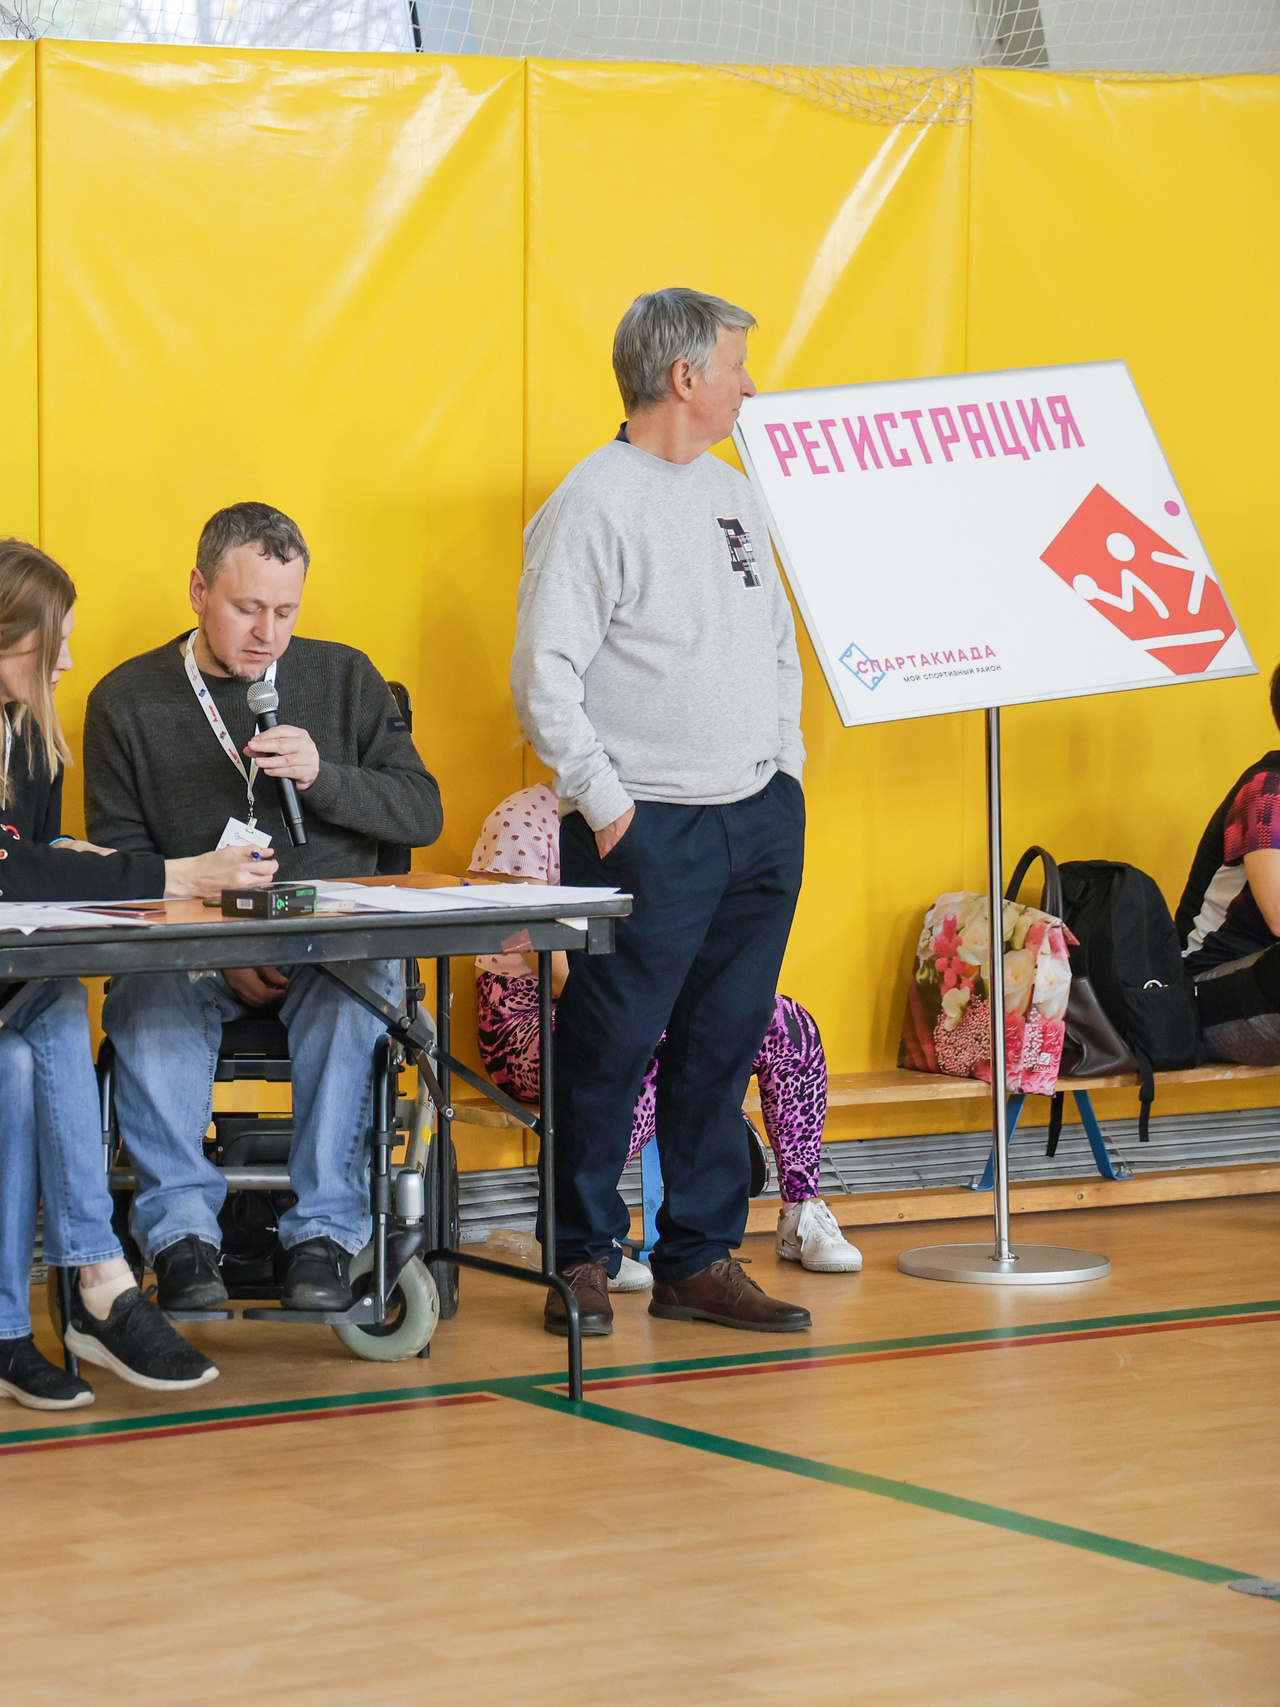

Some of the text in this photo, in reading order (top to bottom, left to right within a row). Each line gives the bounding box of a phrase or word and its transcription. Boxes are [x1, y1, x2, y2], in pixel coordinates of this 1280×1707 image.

[764, 395, 1085, 477] РЕГИСТРАЦИЯ
[856, 645, 997, 674] СПАРТАКИАДА
[903, 665, 1002, 683] МОЙ СПОРТИВНЫЙ РАЙОН
